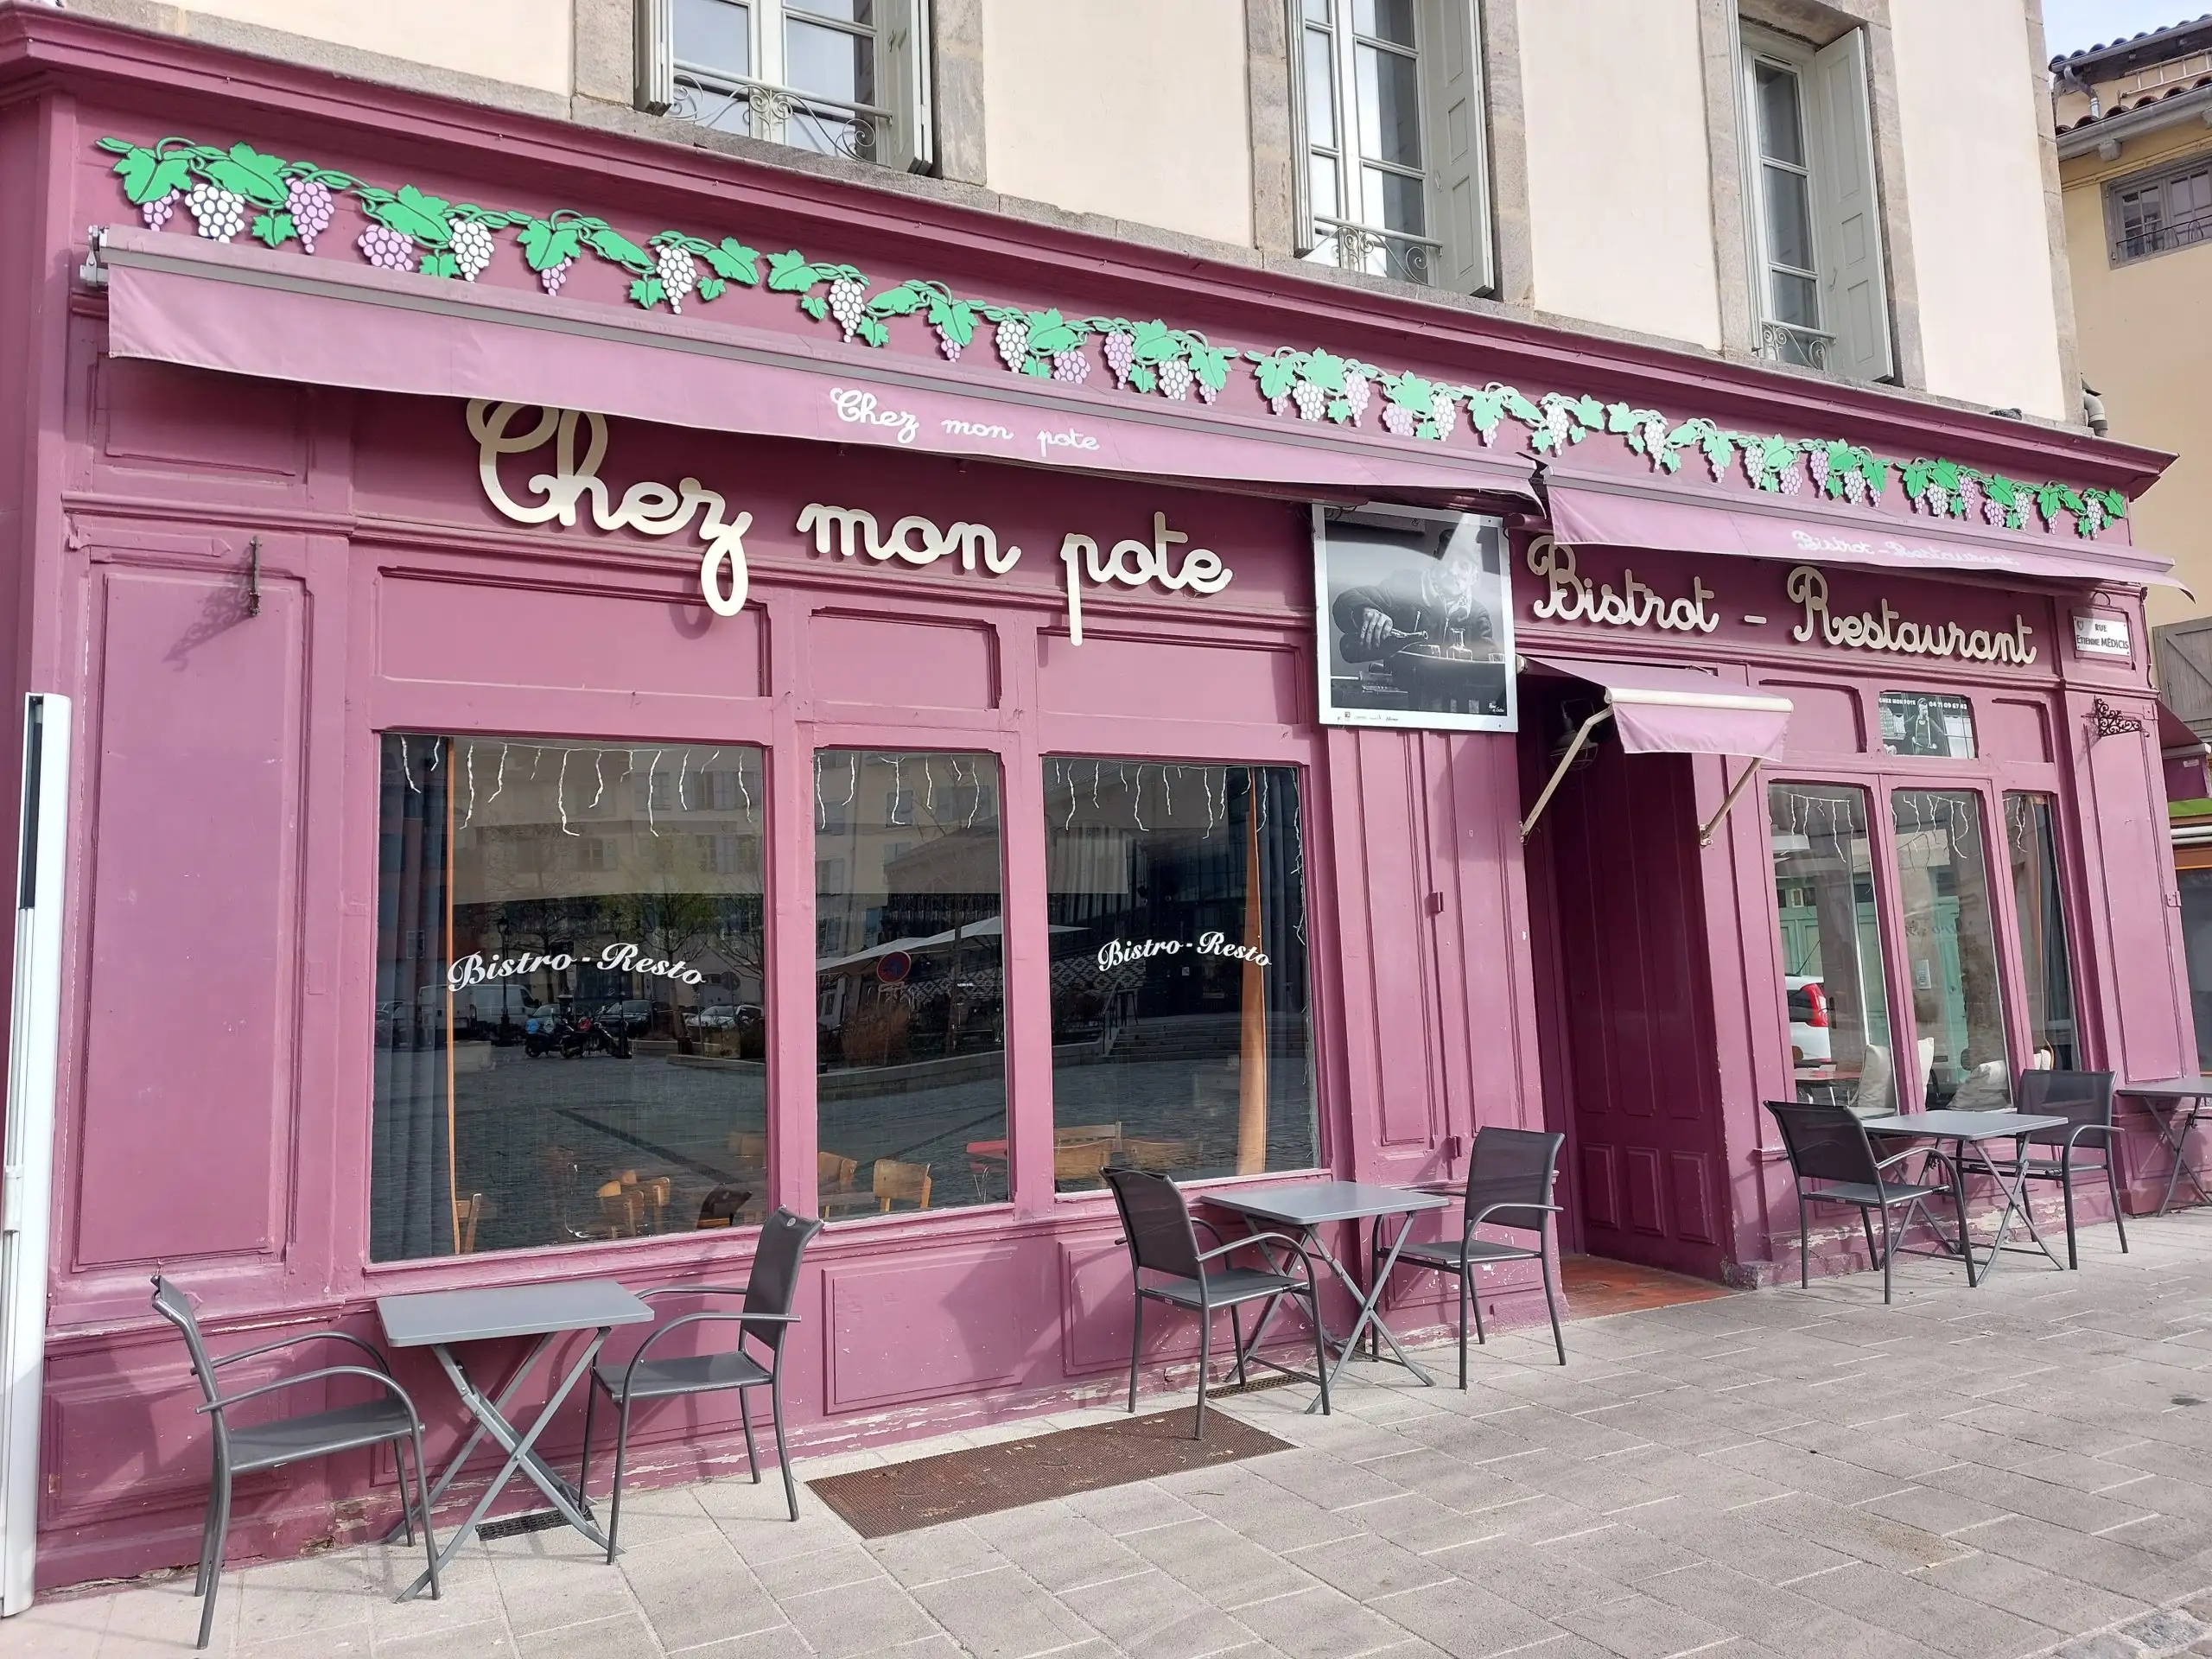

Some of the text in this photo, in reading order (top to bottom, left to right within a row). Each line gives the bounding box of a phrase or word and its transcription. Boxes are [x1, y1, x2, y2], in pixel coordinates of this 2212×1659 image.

[830, 387, 1100, 457] Chez mon pote
[466, 398, 1233, 646] Chez mon pote
[1527, 535, 1720, 632] Bistrot
[1787, 566, 2037, 664] Restaurant
[2094, 623, 2107, 632] RUE
